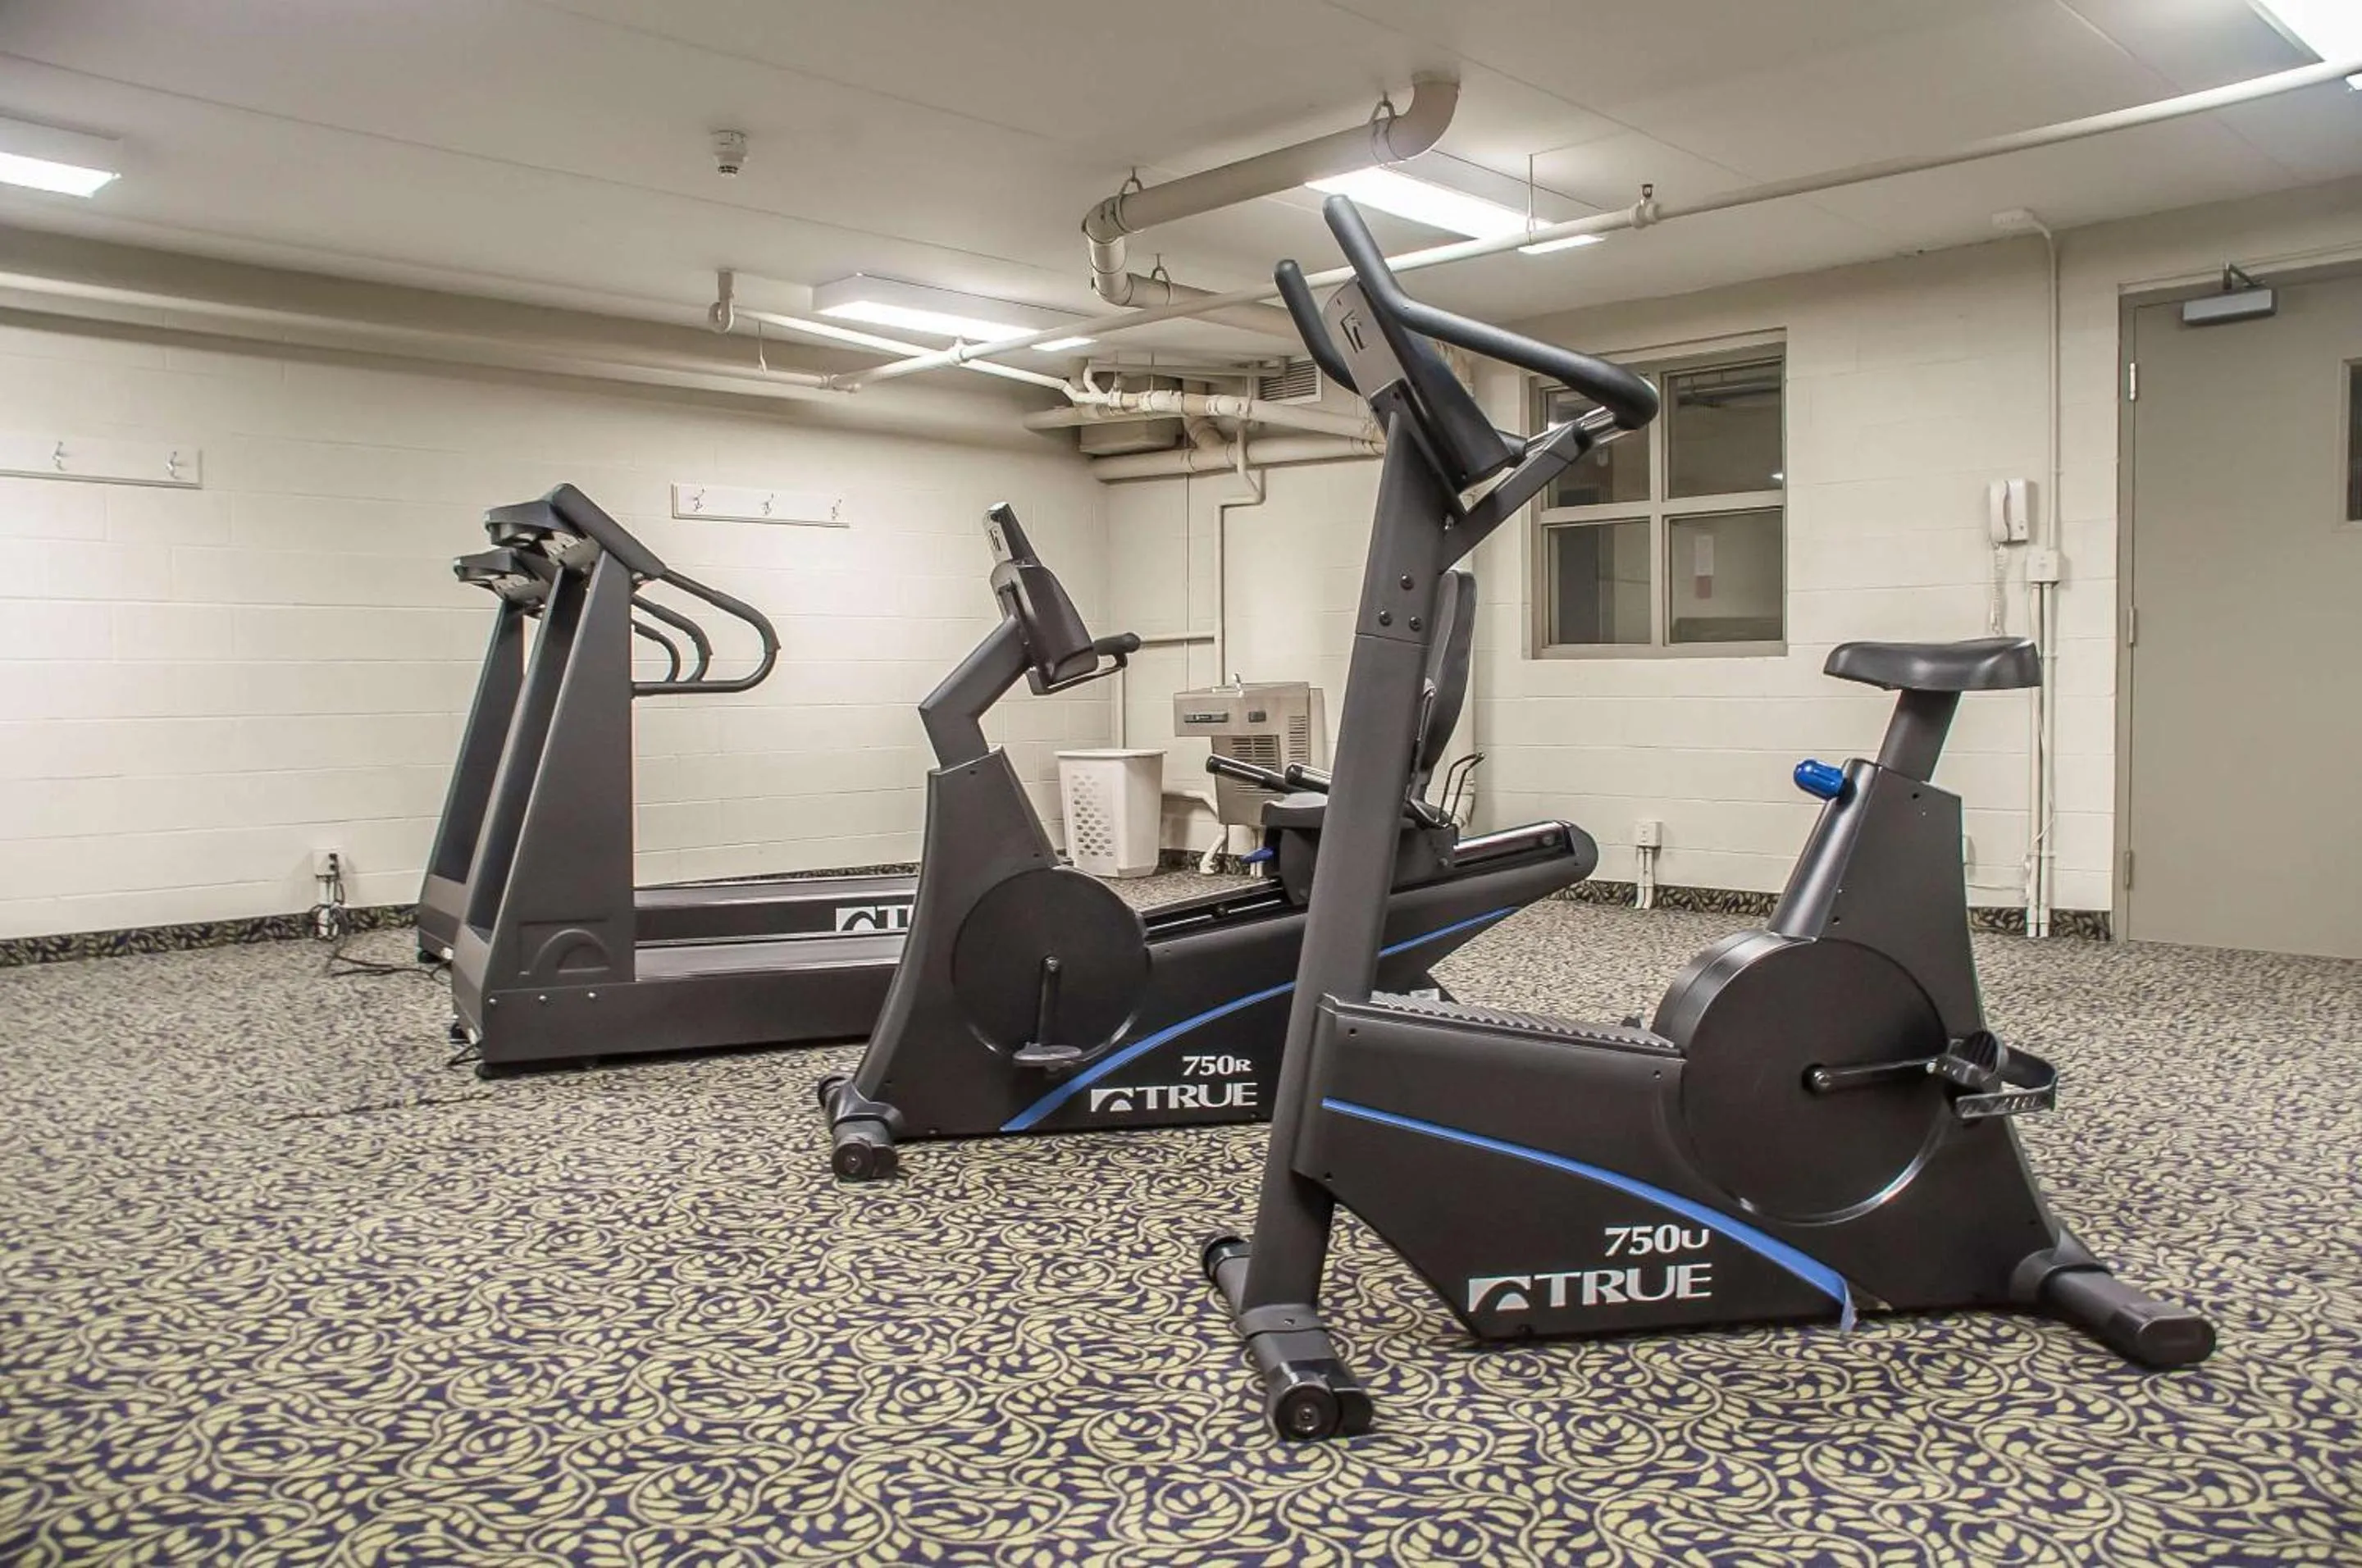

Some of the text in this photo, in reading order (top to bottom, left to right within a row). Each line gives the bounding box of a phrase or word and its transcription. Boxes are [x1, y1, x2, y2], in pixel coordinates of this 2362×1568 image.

[1182, 1055, 1253, 1076] 750R
[1135, 1082, 1258, 1110] TRUE
[1534, 1263, 1712, 1307] TRUE
